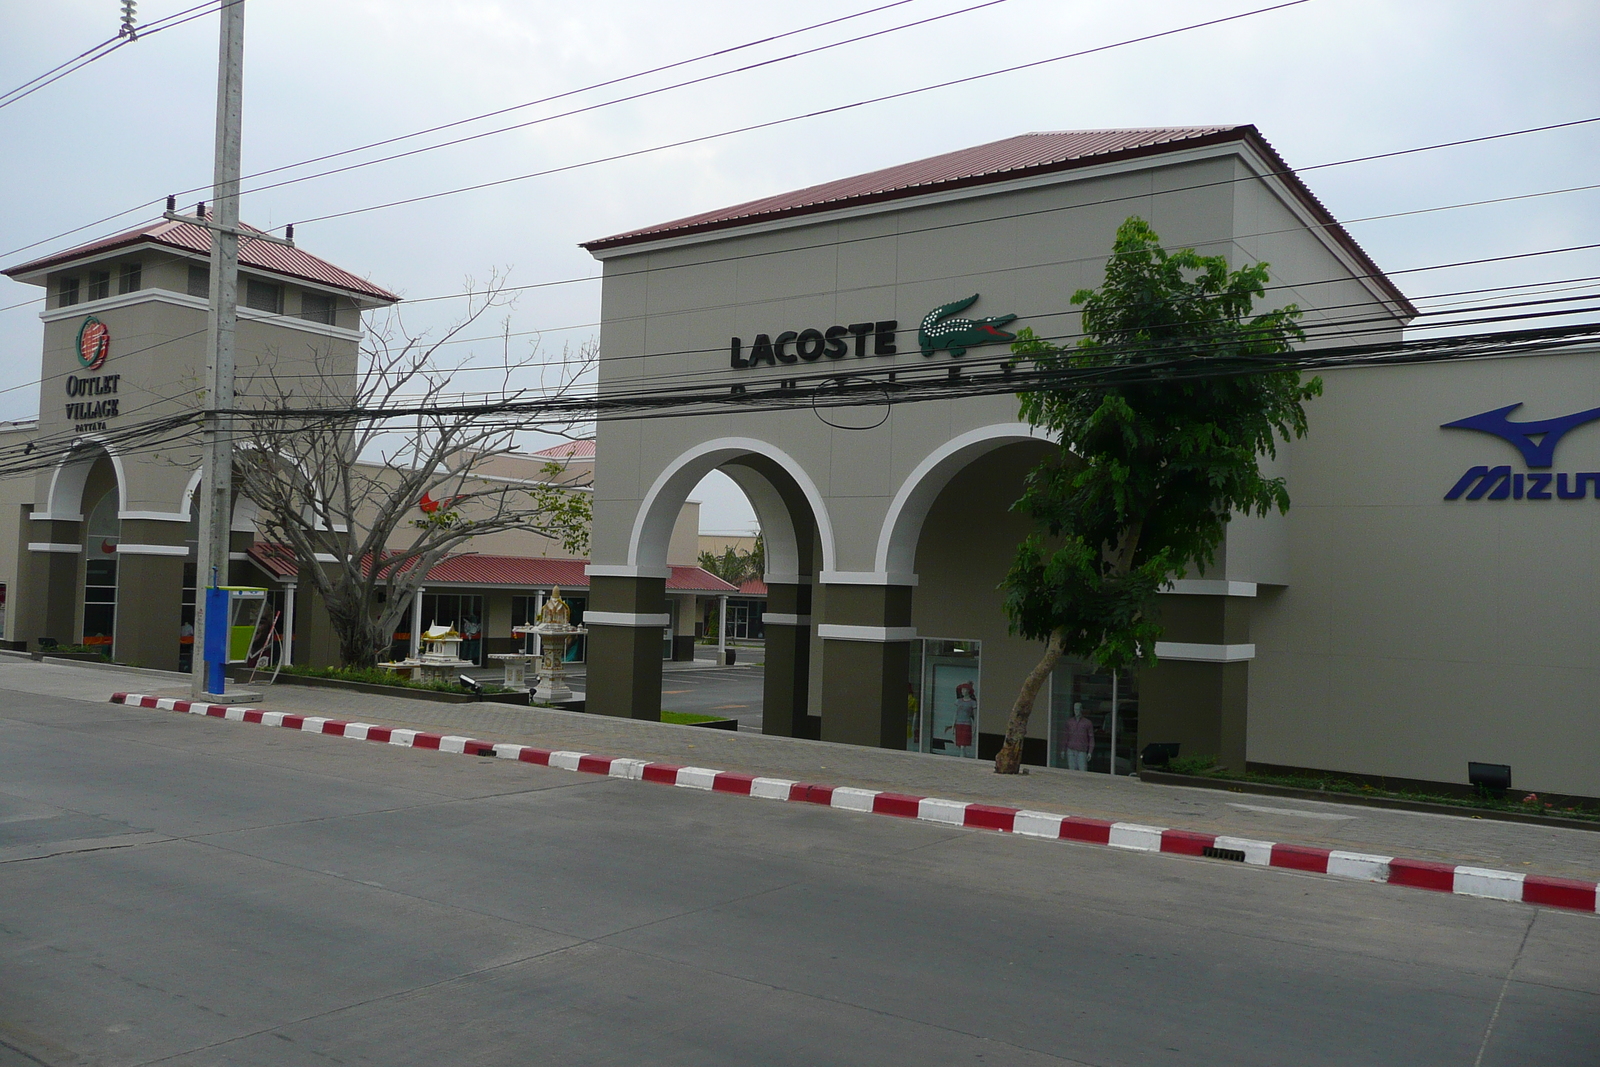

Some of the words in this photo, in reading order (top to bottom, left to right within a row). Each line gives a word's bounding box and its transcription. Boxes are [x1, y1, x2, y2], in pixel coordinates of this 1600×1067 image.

[730, 320, 897, 368] LACOSTE
[66, 374, 120, 397] OUTLET
[65, 399, 119, 420] VILLAGE
[75, 421, 107, 432] PATTAYA
